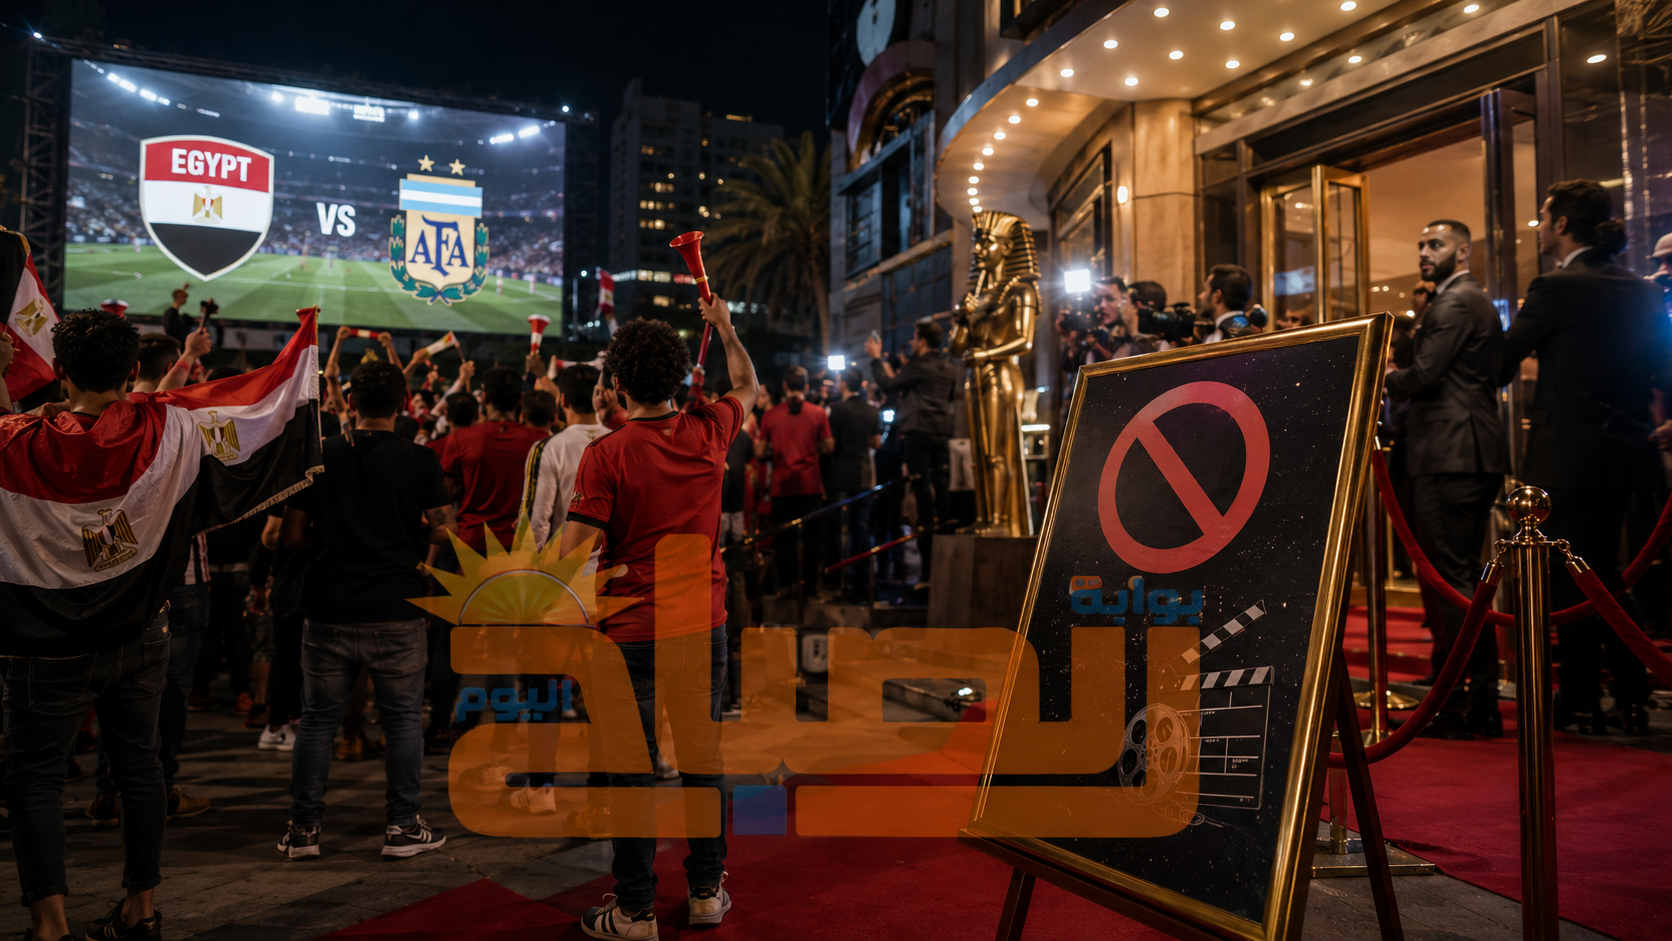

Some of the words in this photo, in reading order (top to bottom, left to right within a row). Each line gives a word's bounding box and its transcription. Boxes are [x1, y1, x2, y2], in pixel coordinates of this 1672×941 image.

[171, 147, 252, 182] EGYPT
[316, 202, 356, 237] VS
[408, 214, 470, 277] AFA
